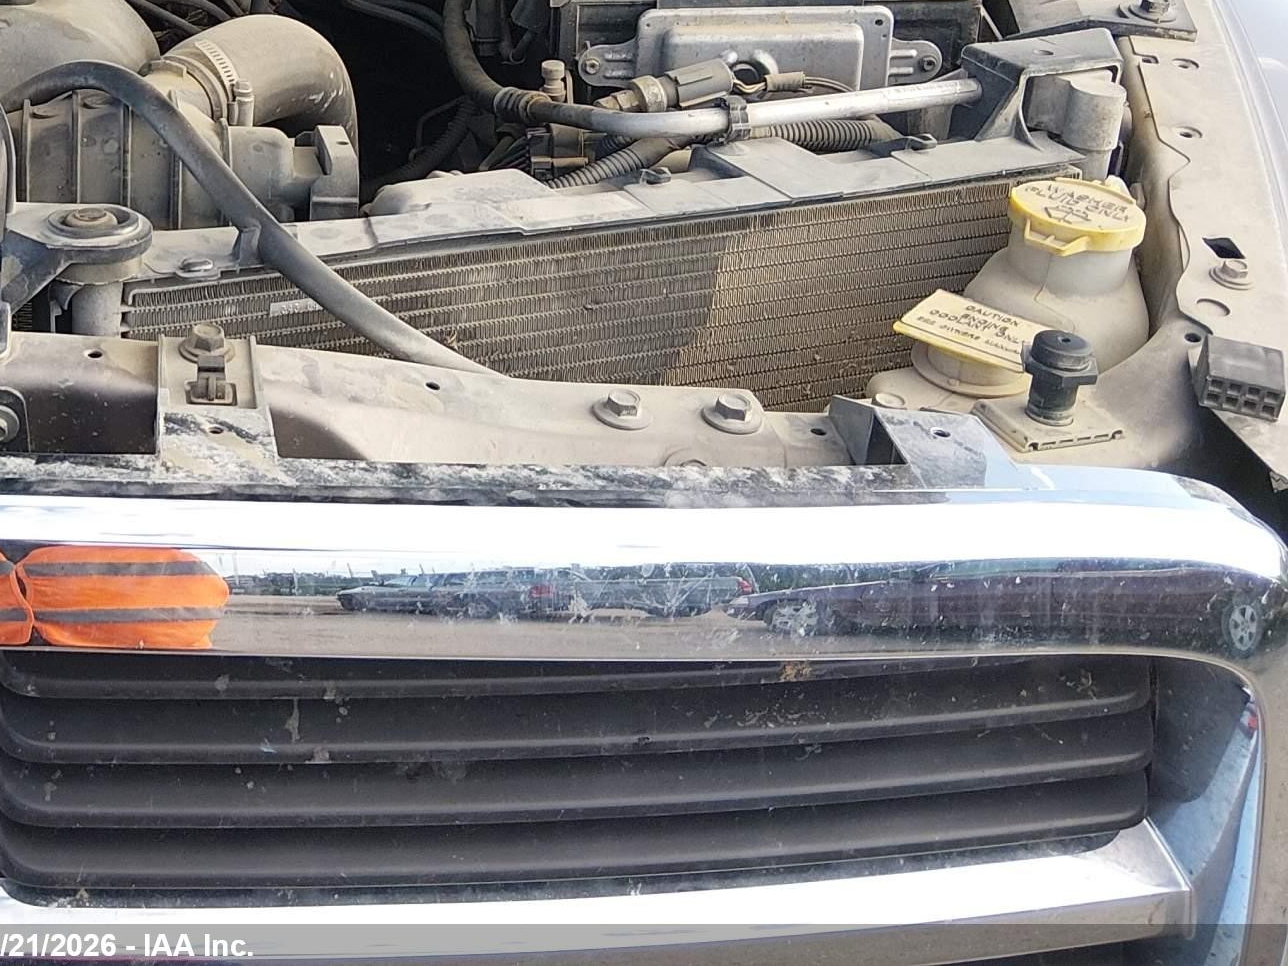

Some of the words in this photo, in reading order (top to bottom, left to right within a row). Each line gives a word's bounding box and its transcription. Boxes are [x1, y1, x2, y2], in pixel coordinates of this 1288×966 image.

[1024, 186, 1079, 205] FLUID
[1085, 205, 1129, 222] ONLY
[1047, 184, 1128, 213] WASHER
[929, 309, 989, 331] COOLANT
[960, 313, 1009, 333] ENGINE
[965, 305, 1019, 327] CAUTION
